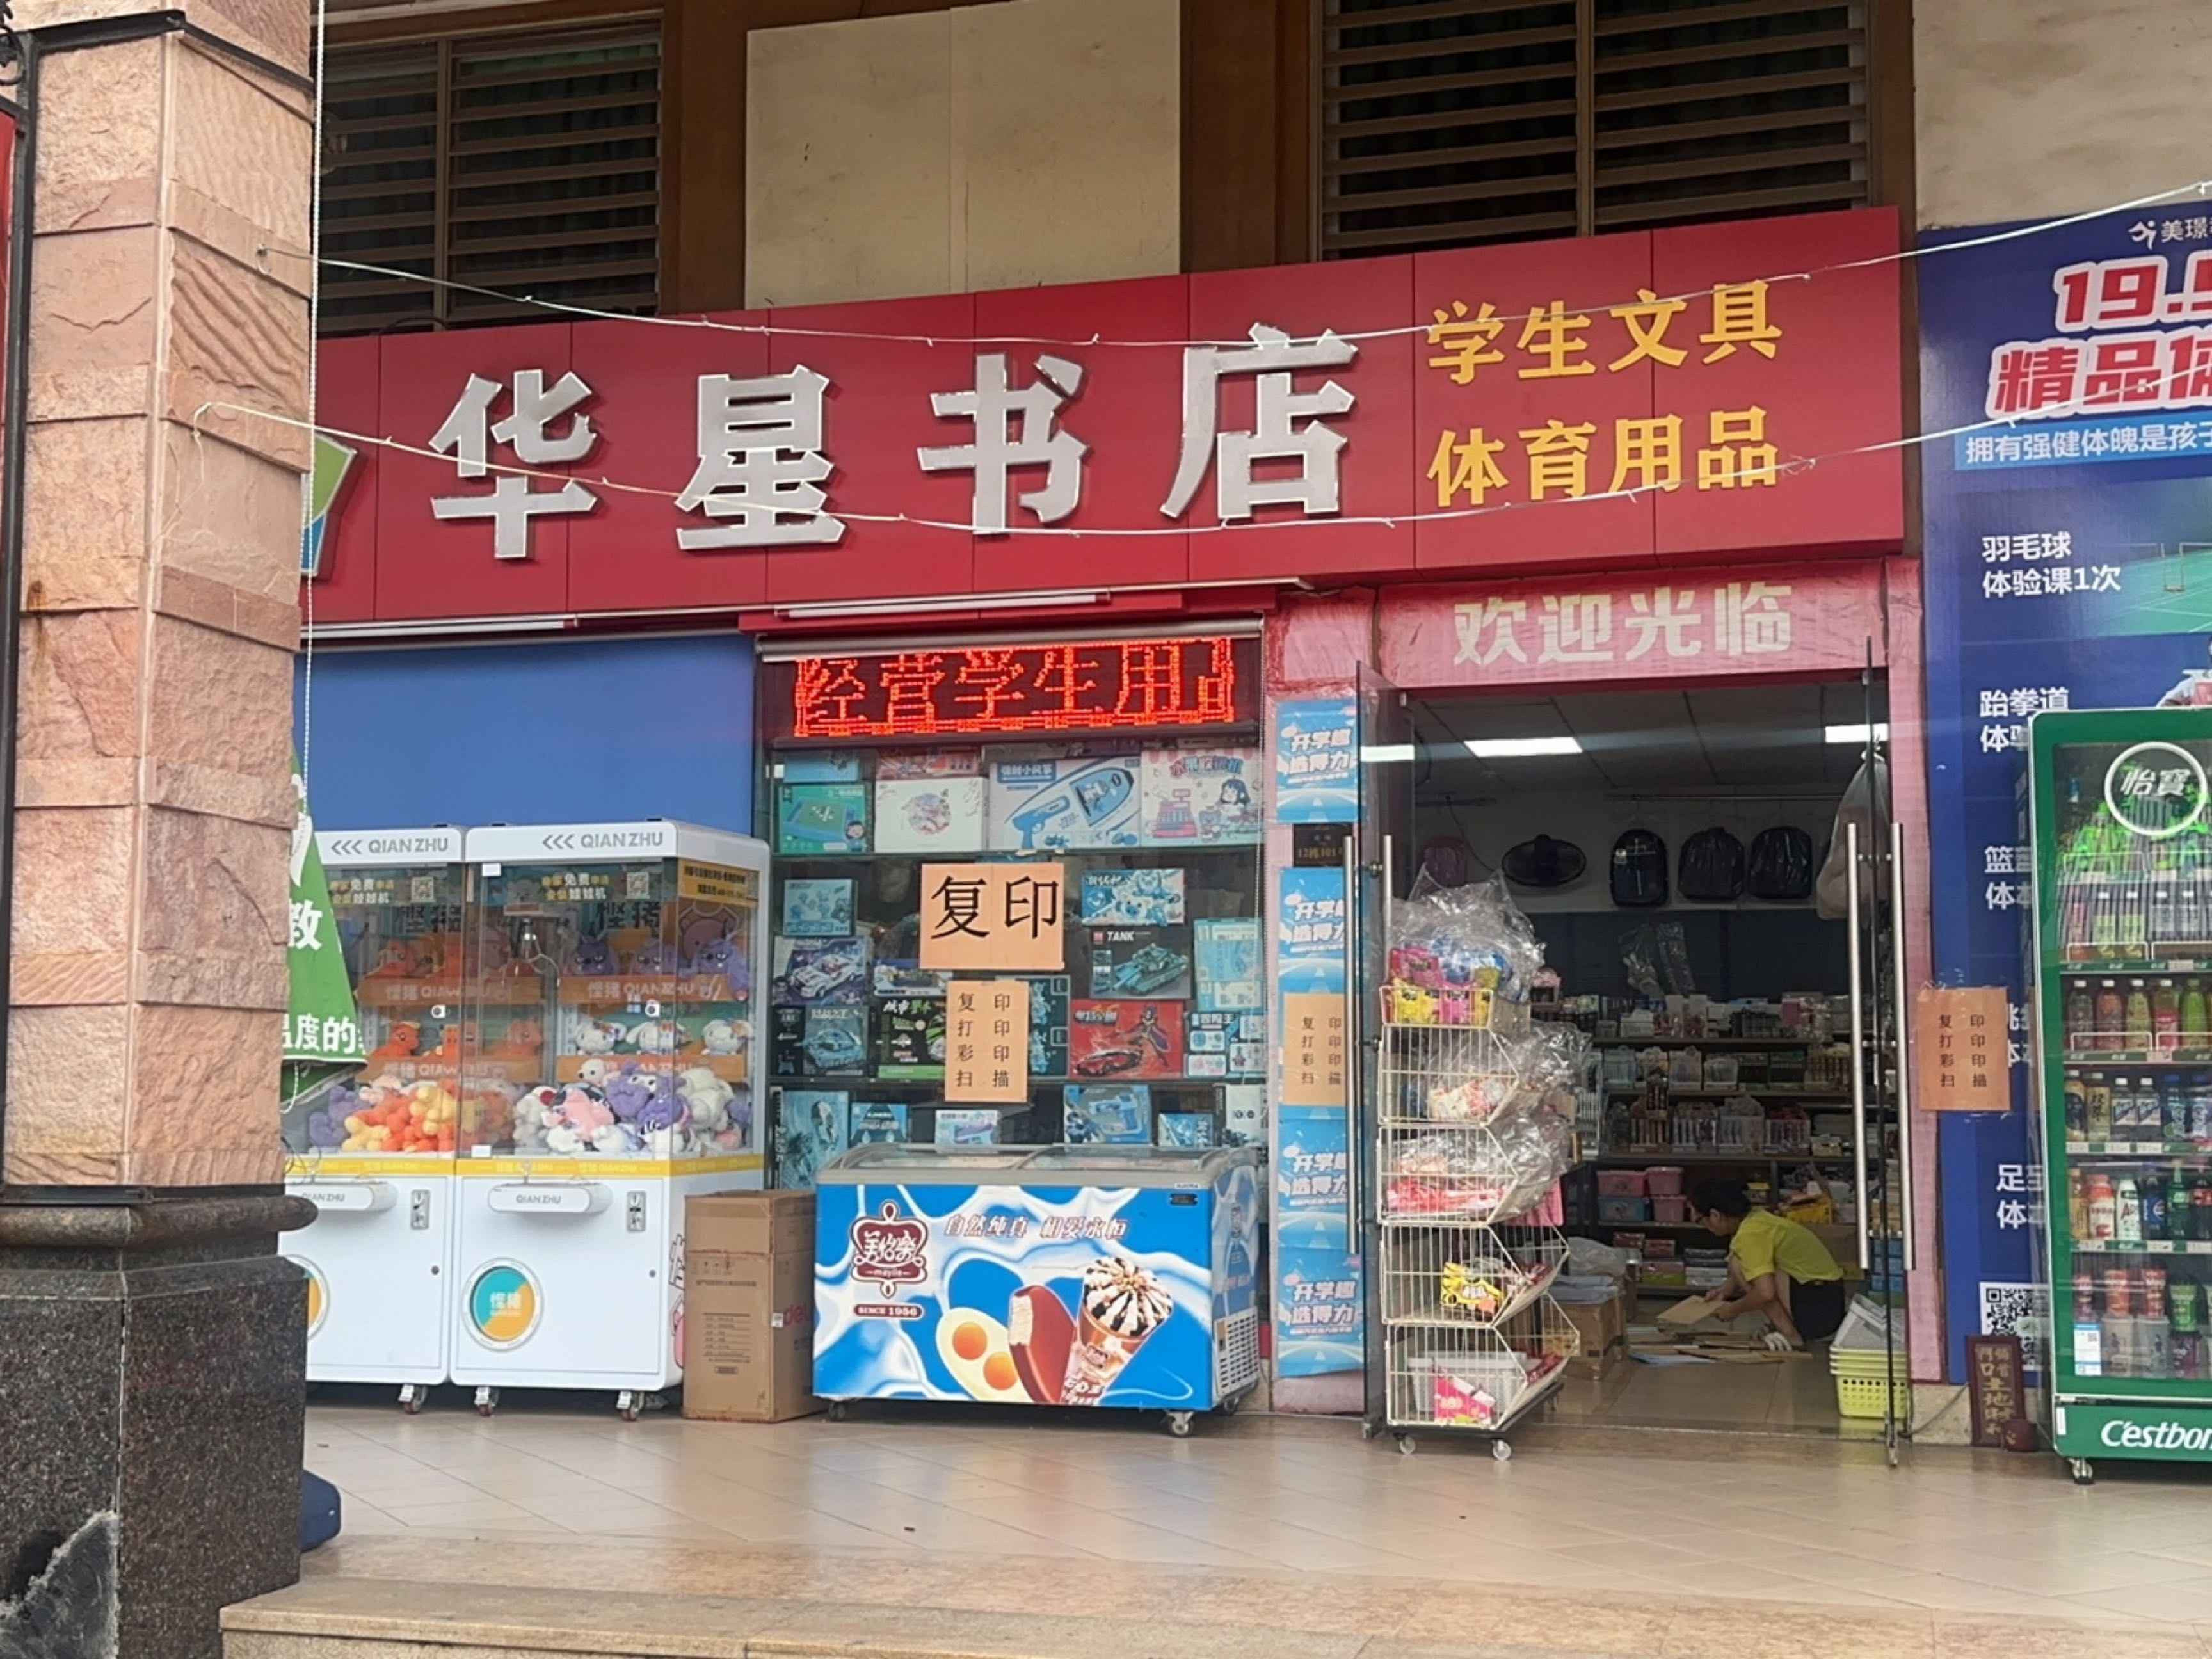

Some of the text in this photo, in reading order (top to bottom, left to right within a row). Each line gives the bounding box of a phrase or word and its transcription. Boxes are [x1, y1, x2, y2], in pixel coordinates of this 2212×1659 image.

[2161, 216, 2212, 243] 美璟
[1427, 280, 1782, 385] 学生文具
[429, 322, 1358, 561] 华星书店
[1427, 405, 1778, 507] 体育用品
[1982, 531, 2072, 563] 羽毛球
[1982, 565, 2122, 598] 体验课1次
[1452, 582, 1793, 666] 欢迎光临
[1980, 687, 2069, 718] 跆拳道
[931, 875, 1059, 940] 复印
[1107, 931, 1134, 942] TANK
[957, 993, 1010, 1011] 复印
[282, 1013, 366, 1055] 度的
[957, 1019, 1010, 1038] 打印
